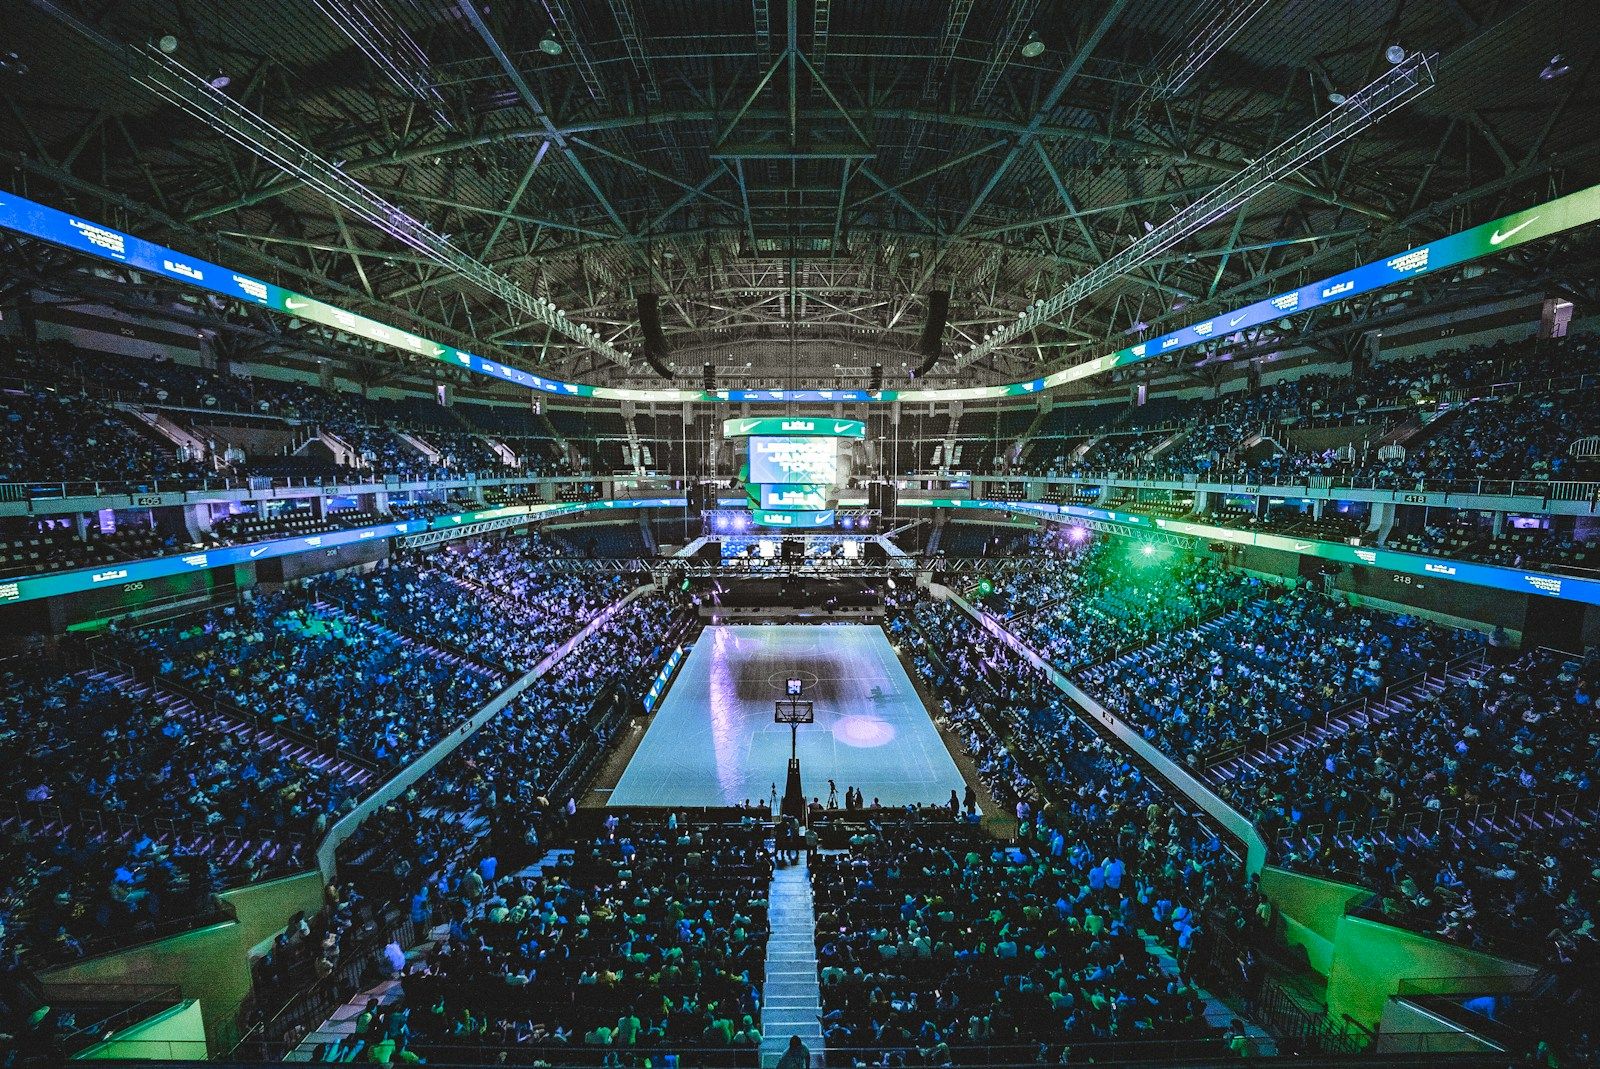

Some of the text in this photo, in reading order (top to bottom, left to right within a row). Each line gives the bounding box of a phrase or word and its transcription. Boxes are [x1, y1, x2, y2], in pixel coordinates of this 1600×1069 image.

[140, 497, 160, 505] 405
[1406, 495, 1425, 504] 418
[1393, 574, 1412, 585] 218
[124, 581, 144, 592] 205
